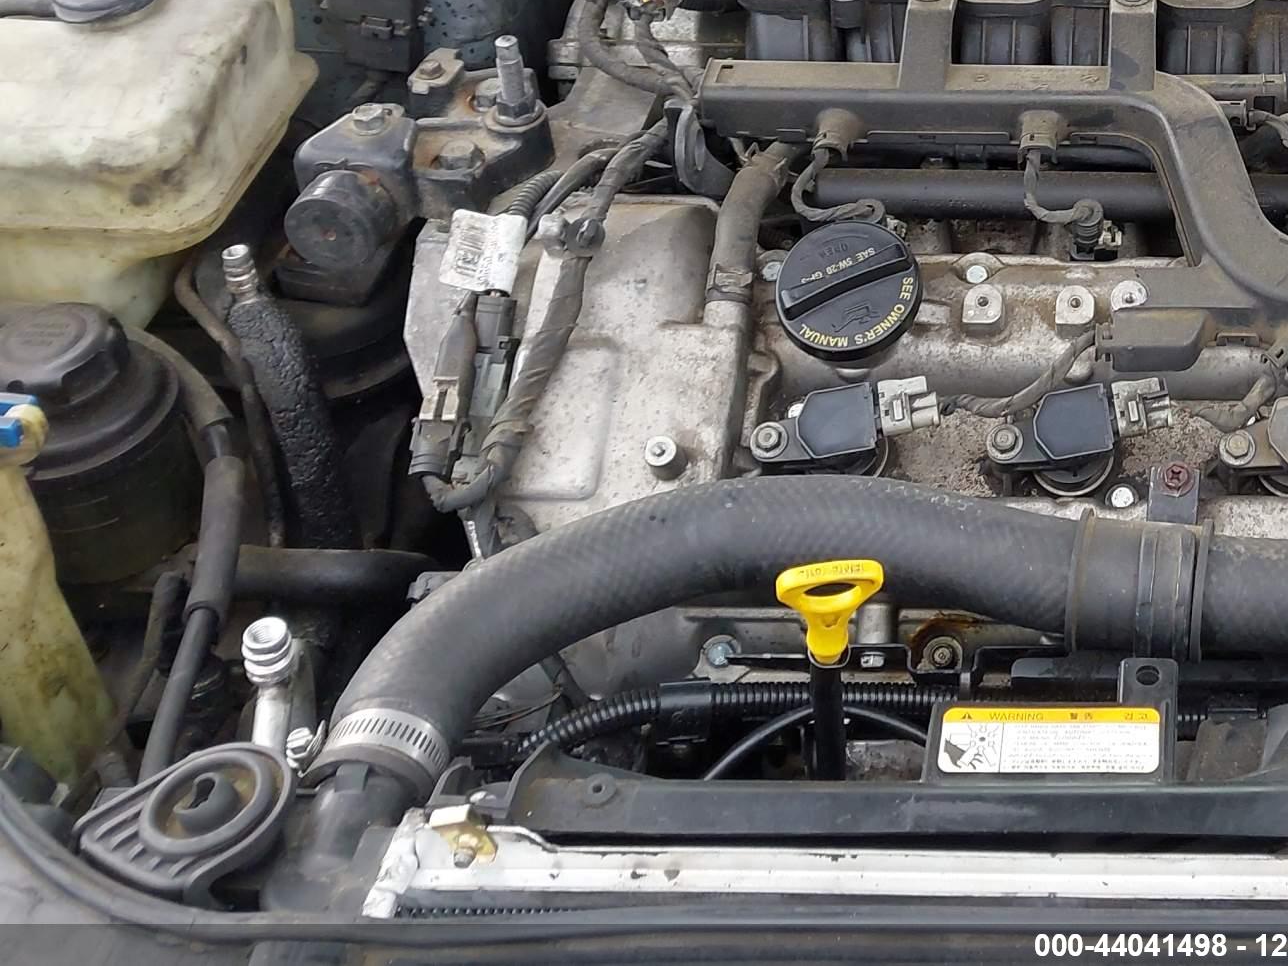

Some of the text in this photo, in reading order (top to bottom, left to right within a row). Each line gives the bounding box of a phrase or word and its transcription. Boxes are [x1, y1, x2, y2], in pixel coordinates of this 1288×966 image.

[855, 247, 876, 259] SAE
[825, 257, 853, 275] 5W-20
[799, 277, 914, 348] SEE OWNER'S MANUAL
[988, 712, 1045, 721] WARNING
